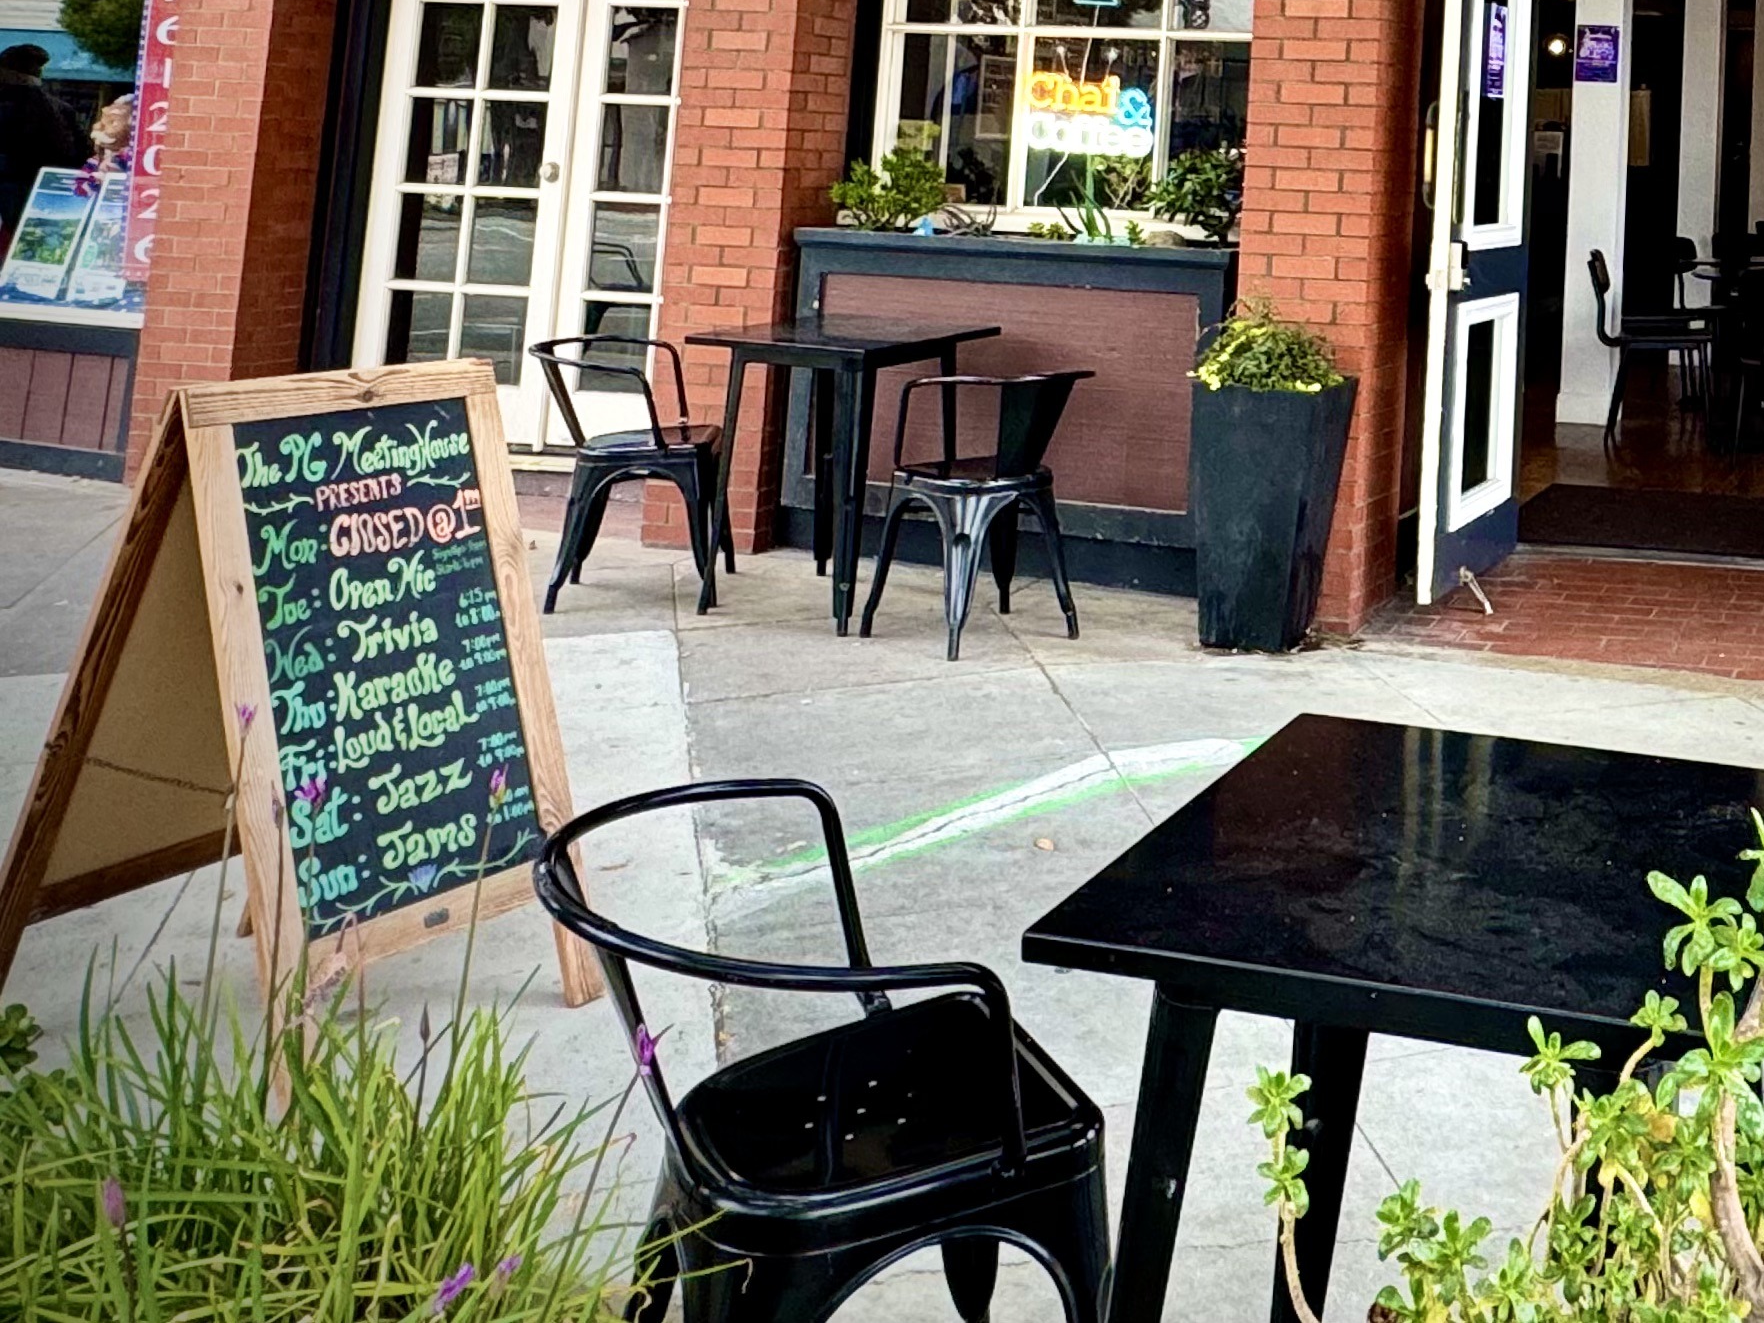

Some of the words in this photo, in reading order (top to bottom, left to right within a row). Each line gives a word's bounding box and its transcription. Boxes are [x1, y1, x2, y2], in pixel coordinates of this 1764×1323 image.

[1029, 71, 1120, 114] Chai
[1118, 87, 1153, 126] &
[236, 441, 283, 489] The
[280, 432, 328, 483] PG
[316, 473, 402, 512] PRESENTS
[252, 519, 329, 577] Mon:
[258, 573, 322, 630] Tue:
[329, 567, 396, 611] Open
[387, 549, 437, 602] Mic
[265, 625, 337, 683] Wed:
[337, 611, 438, 663] Trivia
[271, 681, 338, 735] Thu:
[333, 653, 457, 722] Karaoke
[279, 739, 338, 792] Fri:
[334, 711, 395, 774] Loud
[406, 690, 480, 751] Local
[290, 786, 364, 850] Sat:
[368, 758, 473, 814] Jazz
[298, 855, 371, 909] Sun:
[377, 813, 478, 870] Jams
